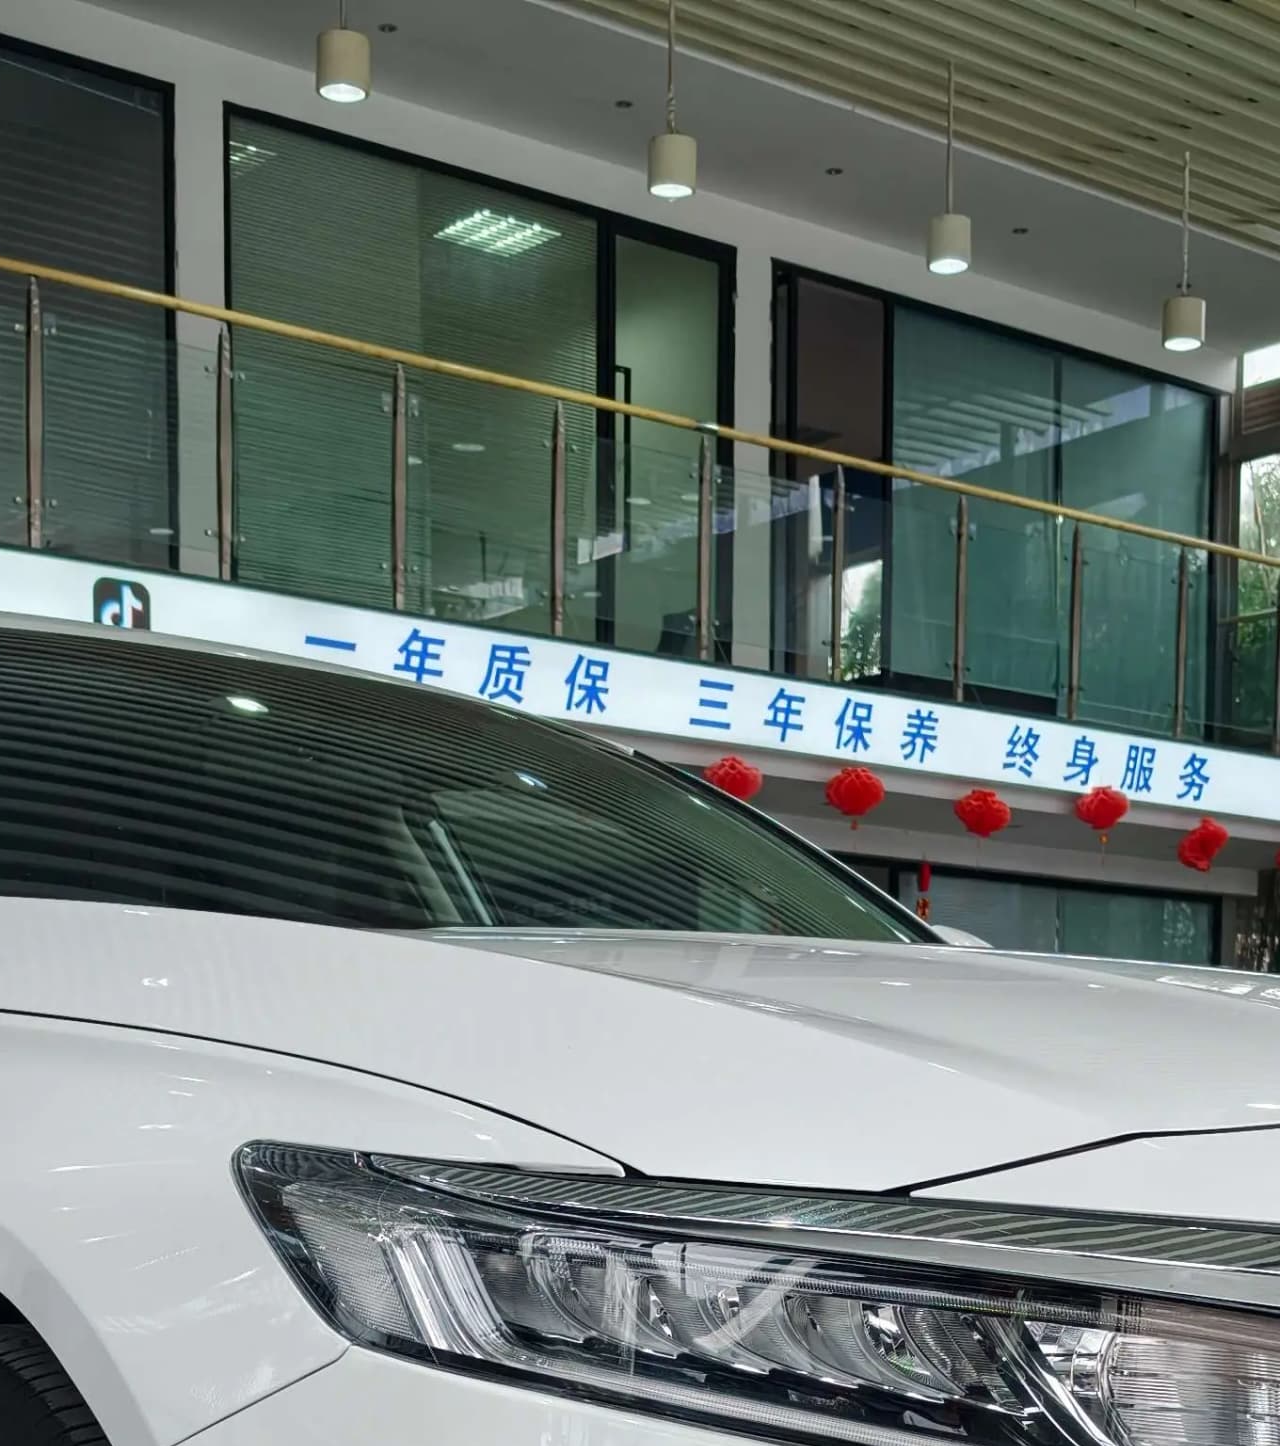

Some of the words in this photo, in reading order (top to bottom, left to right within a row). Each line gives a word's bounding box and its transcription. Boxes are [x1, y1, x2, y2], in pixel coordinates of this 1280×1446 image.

[305, 627, 610, 714] 一年质保
[689, 679, 939, 764] 三年保养
[1002, 725, 1211, 801] 终身服务
